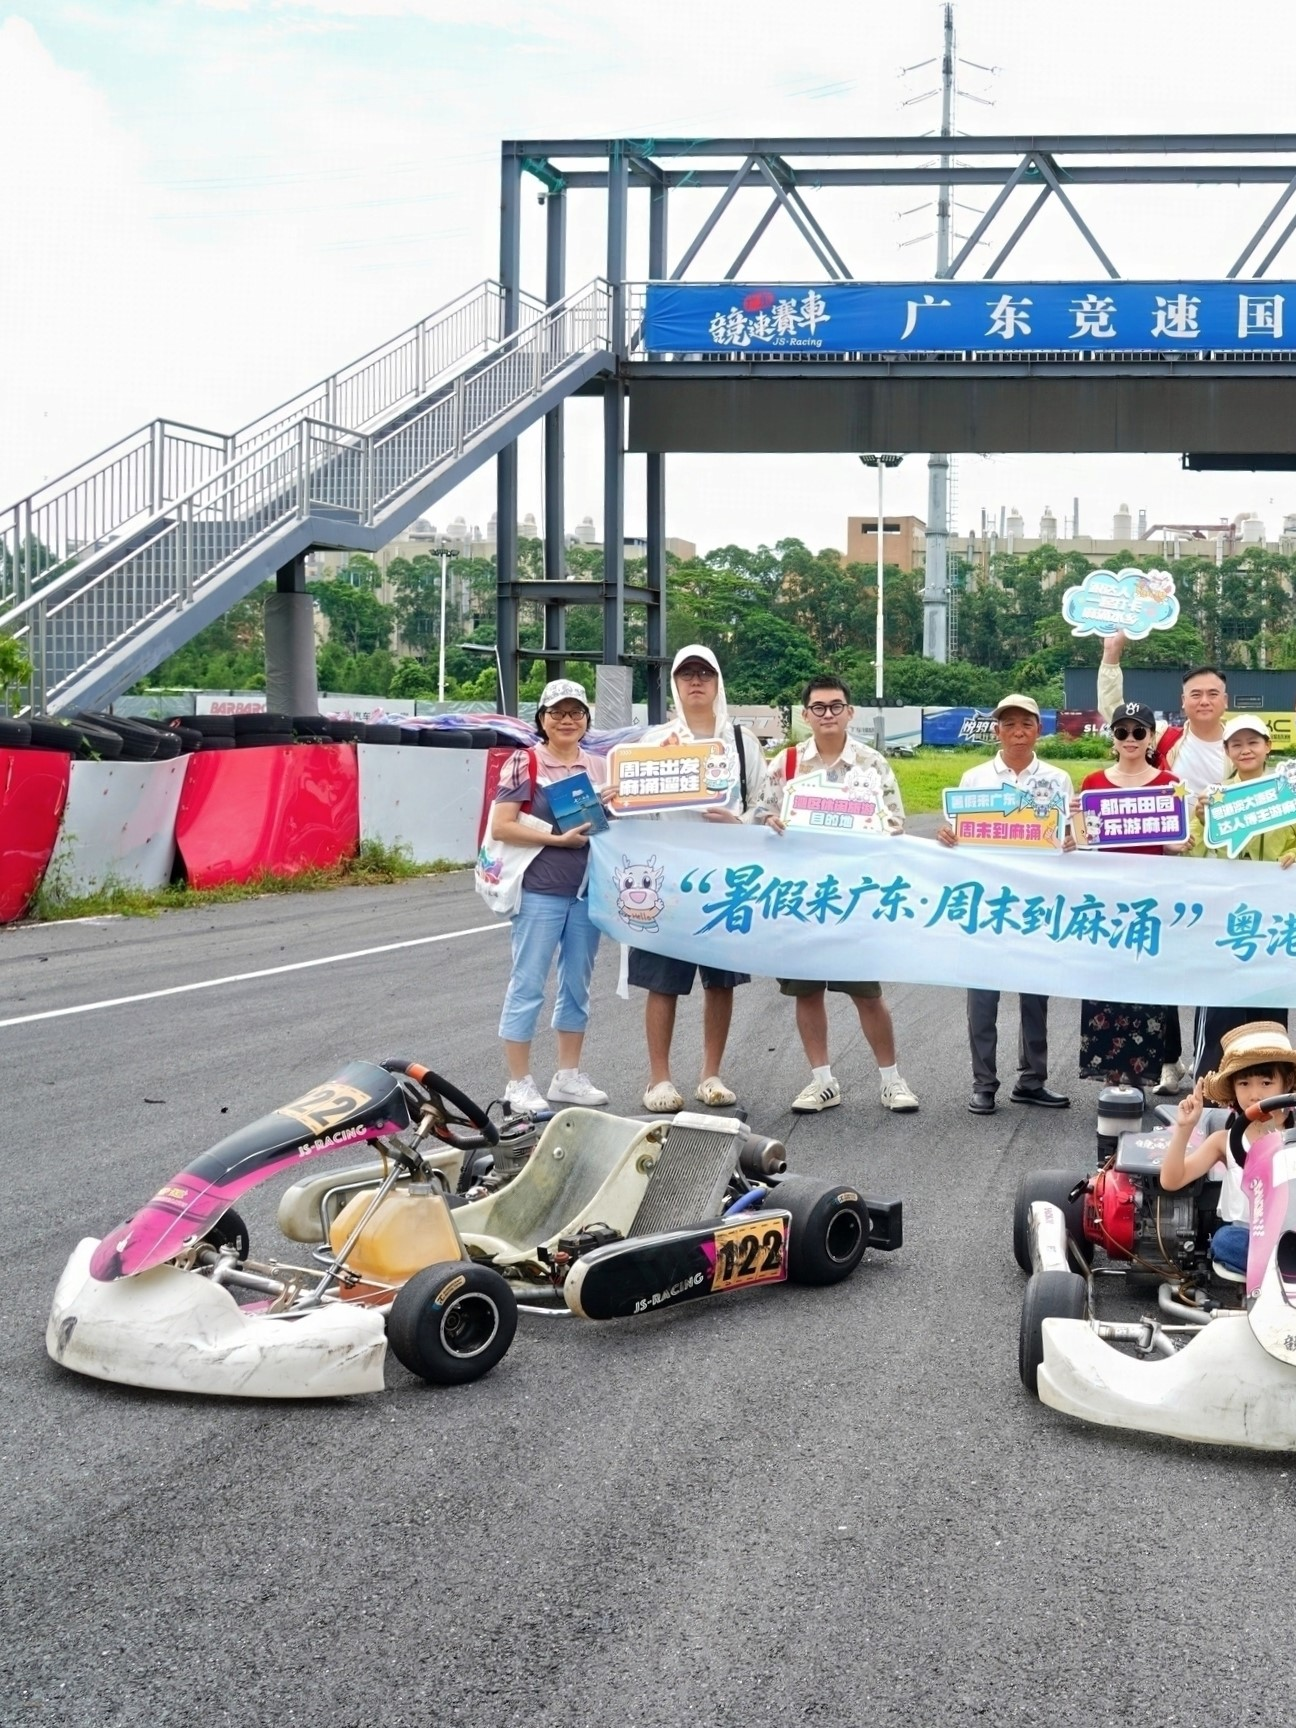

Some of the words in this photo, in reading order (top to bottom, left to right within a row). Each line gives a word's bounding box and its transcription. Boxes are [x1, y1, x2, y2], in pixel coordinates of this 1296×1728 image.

[619, 757, 699, 779] 周末出发
[619, 776, 700, 797] 麻涌遛娃
[793, 795, 876, 817] 湾区休闲旅游
[951, 793, 1017, 809] 暑假来广东
[1100, 795, 1176, 816] 都市田园
[809, 812, 854, 829] 目的地
[959, 821, 1042, 841] 周末到麻涌
[1104, 815, 1180, 836] 乐游麻涌
[298, 1124, 368, 1158] JS-RACING
[719, 1229, 783, 1282] 122
[633, 1272, 704, 1314] JS-RACING
